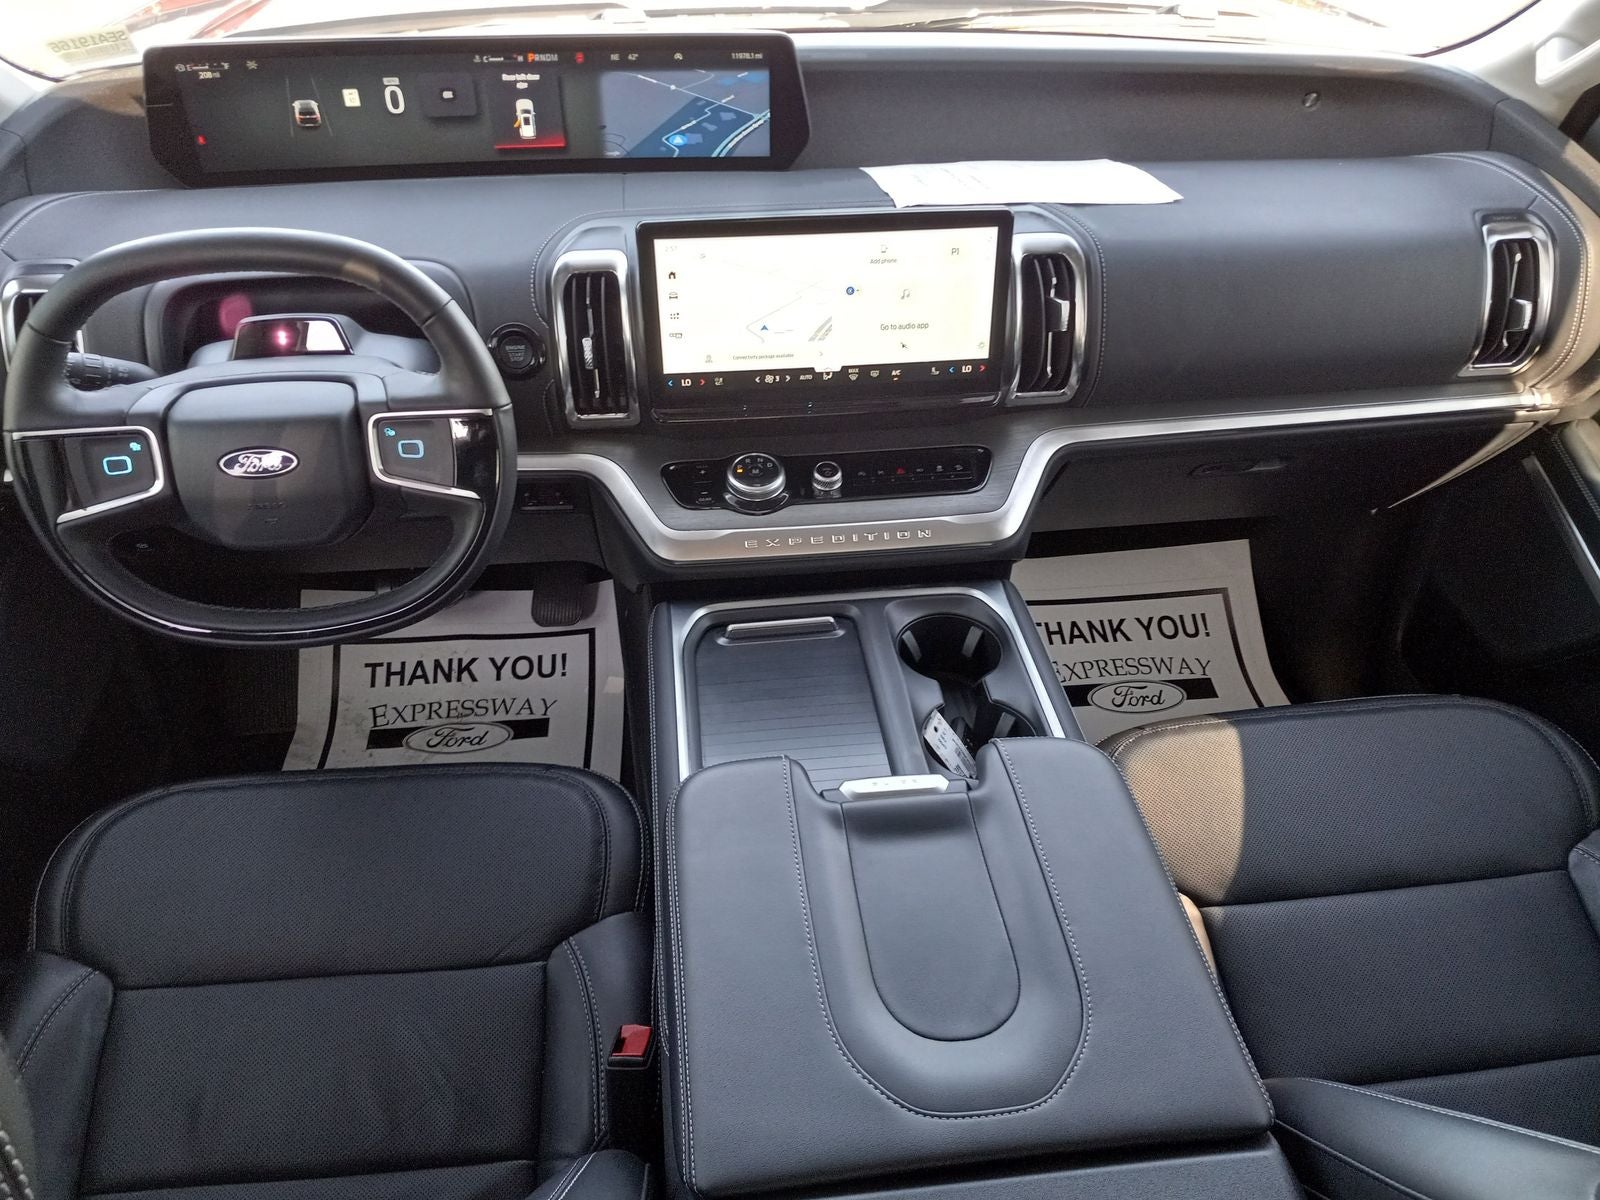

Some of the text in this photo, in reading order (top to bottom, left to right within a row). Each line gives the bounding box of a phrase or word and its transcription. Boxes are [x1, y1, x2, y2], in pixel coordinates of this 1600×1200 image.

[384, 85, 405, 114] 0
[880, 323, 889, 331] Go
[898, 322, 916, 330] audio
[744, 529, 932, 549] EXPEDITION
[1035, 612, 1211, 645] HANK YOU!
[364, 652, 568, 687] THANK YOU!
[1111, 685, 1166, 708] Ford
[368, 697, 558, 729] EXPRESSWAY
[425, 726, 489, 749] Ford
